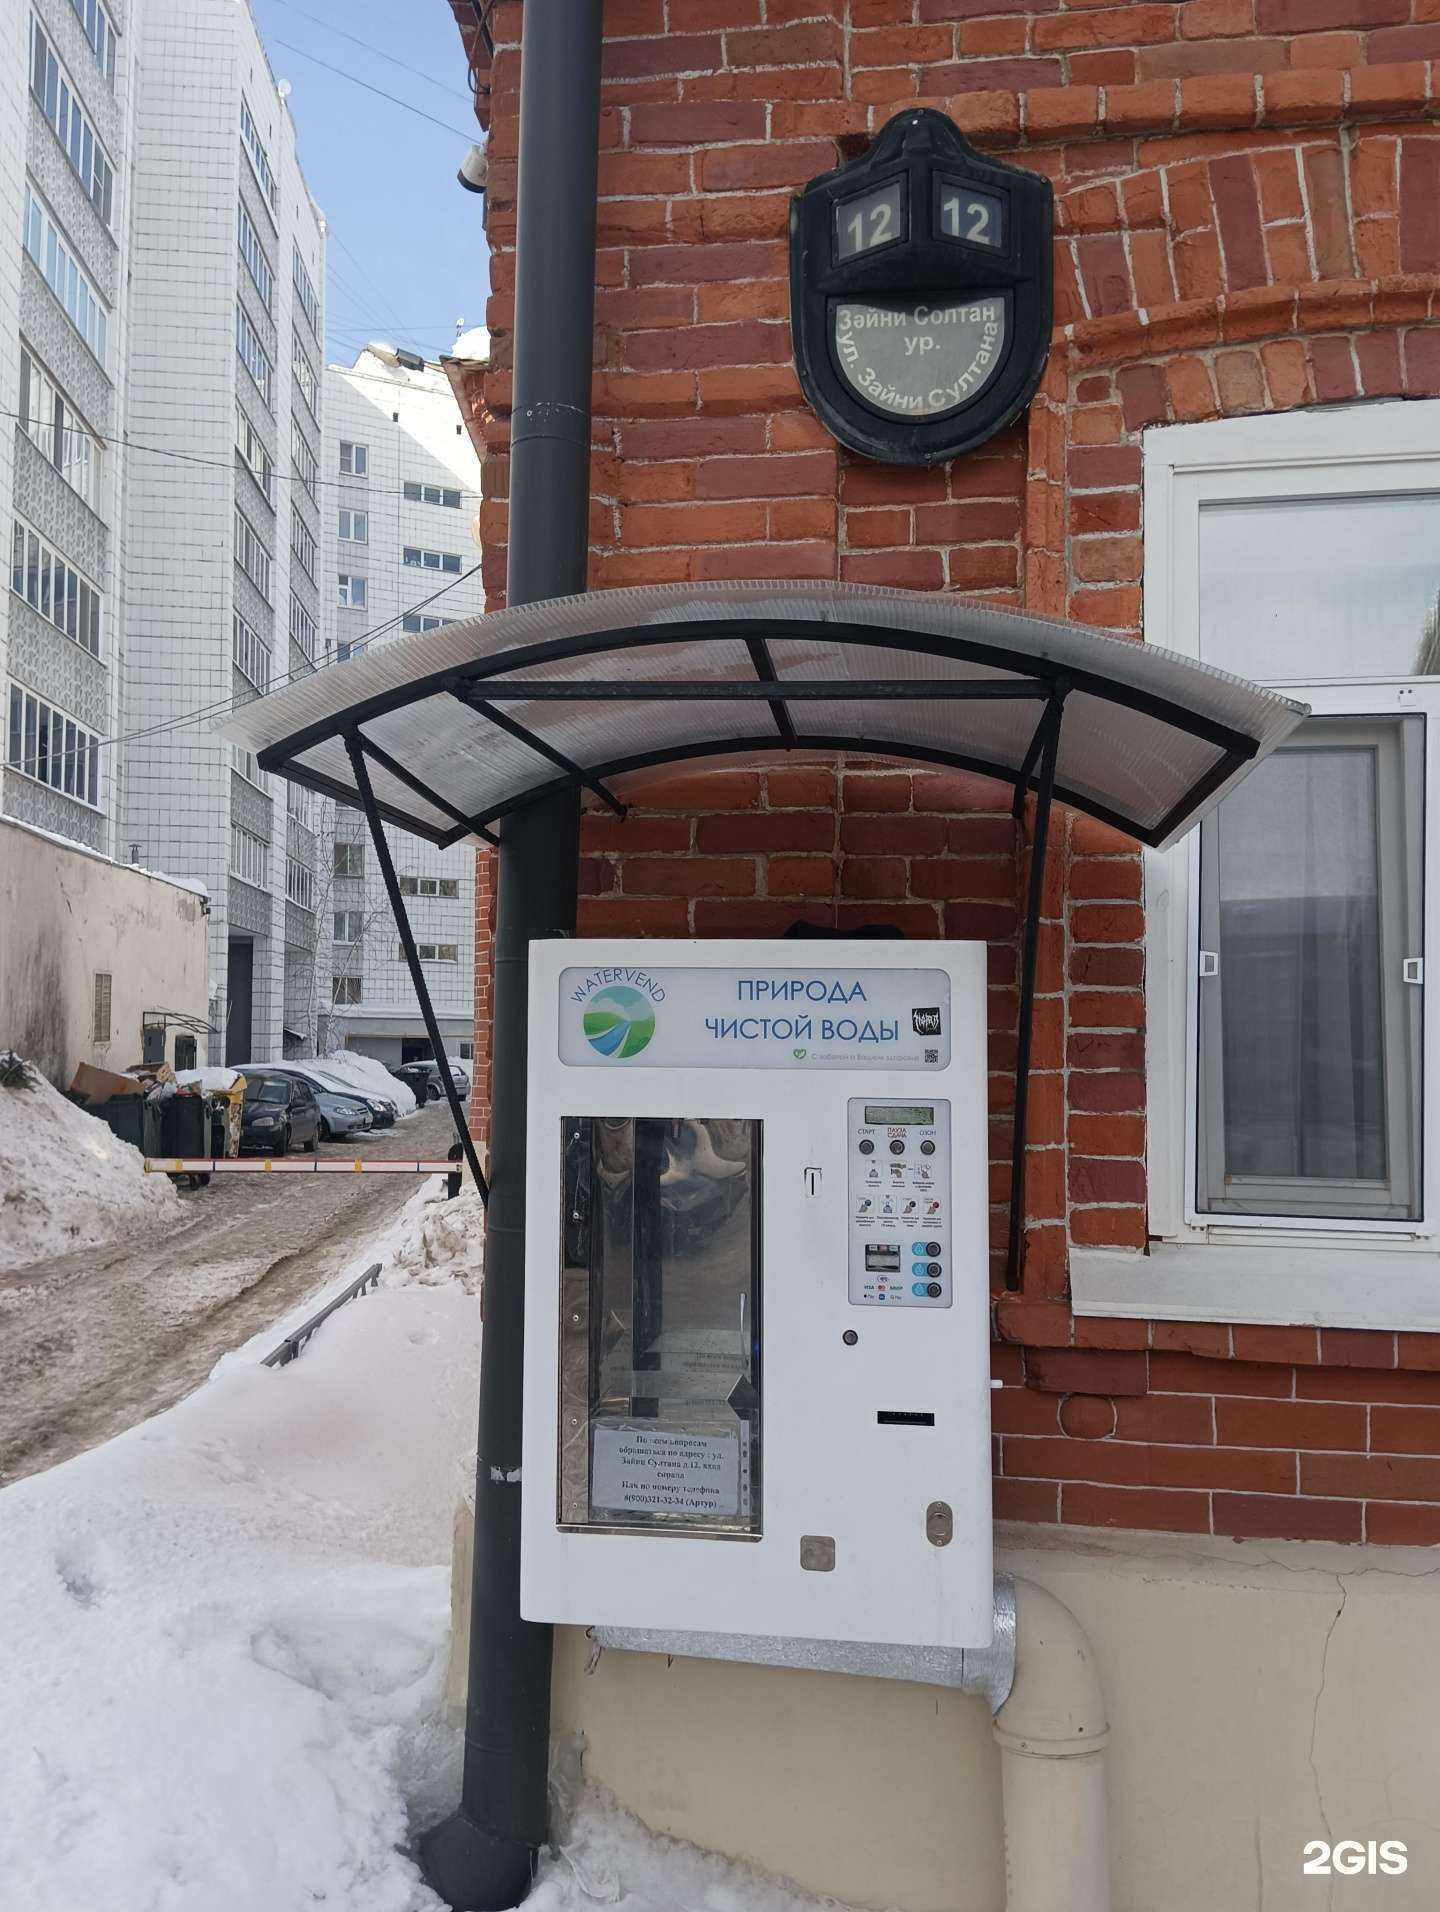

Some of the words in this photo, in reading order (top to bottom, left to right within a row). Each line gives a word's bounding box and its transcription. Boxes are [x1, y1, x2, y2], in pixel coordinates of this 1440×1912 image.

[848, 203, 892, 251] 12
[943, 197, 990, 246] 12
[839, 308, 906, 330] Зәйни
[913, 306, 995, 326] Солтан
[904, 335, 941, 356] ур.
[837, 331, 860, 369] ул.
[858, 368, 924, 409] Зайни
[928, 322, 999, 407] Султана
[570, 968, 666, 1002] WATERVEND
[737, 980, 867, 1004] ПРИРОДА
[705, 1015, 812, 1040] ЧИСТОЙ
[821, 1019, 899, 1043] ВОДЫ
[858, 1128, 876, 1136] СТАРТ
[636, 1435, 648, 1444] По
[647, 1458, 681, 1468] Султана
[621, 1480, 639, 1489] Или
[652, 1484, 681, 1494] номеру
[682, 1485, 720, 1495] телефона
